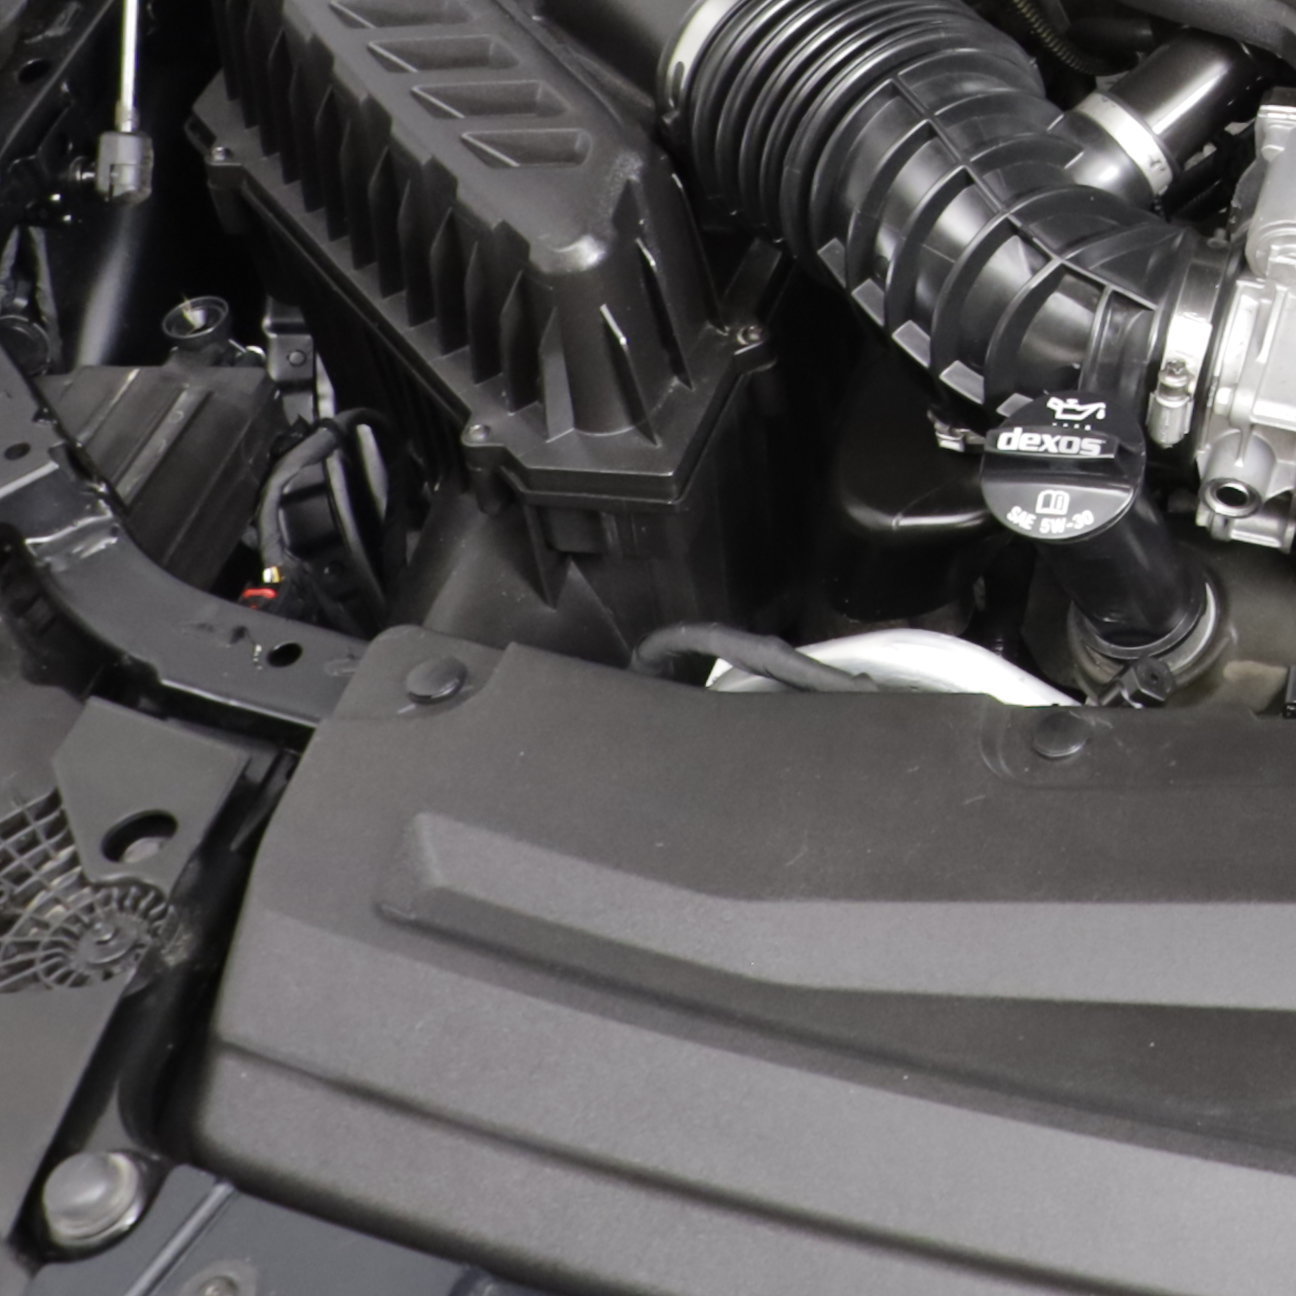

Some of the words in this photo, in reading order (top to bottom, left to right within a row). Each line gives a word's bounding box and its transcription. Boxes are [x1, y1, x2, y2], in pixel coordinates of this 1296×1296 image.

[997, 427, 1107, 456] dexos
[1006, 505, 1037, 530] SAE
[1039, 509, 1095, 534] 5W-30
